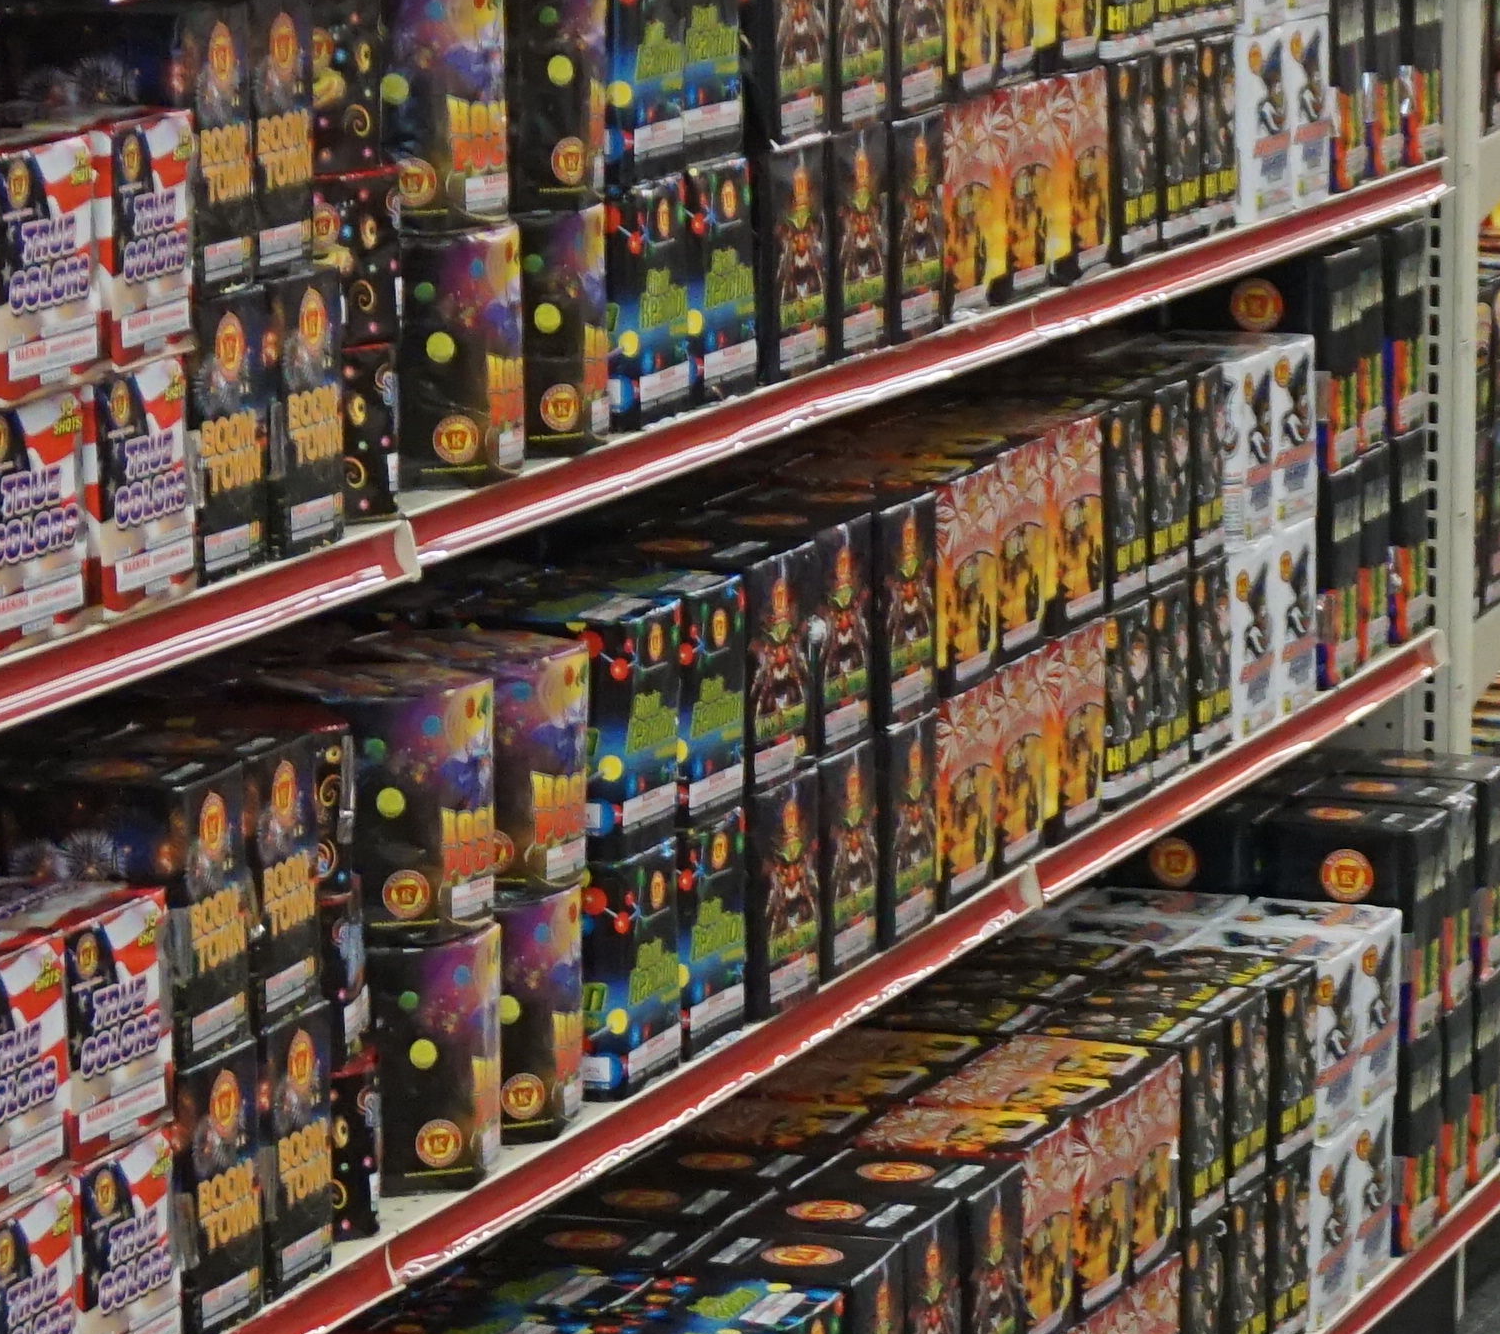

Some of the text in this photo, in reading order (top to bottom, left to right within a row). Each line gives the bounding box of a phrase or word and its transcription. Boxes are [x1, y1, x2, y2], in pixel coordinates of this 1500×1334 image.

[256, 109, 311, 155] BOOM
[262, 144, 314, 190] TOWN
[20, 213, 76, 264] TRUE
[6, 254, 91, 316] COLORS
[201, 409, 257, 457] BOOM
[0, 464, 65, 515] TRUE
[208, 449, 262, 494] TOWN
[197, 1158, 255, 1216] BOOM
[205, 1193, 260, 1251] TOWN
